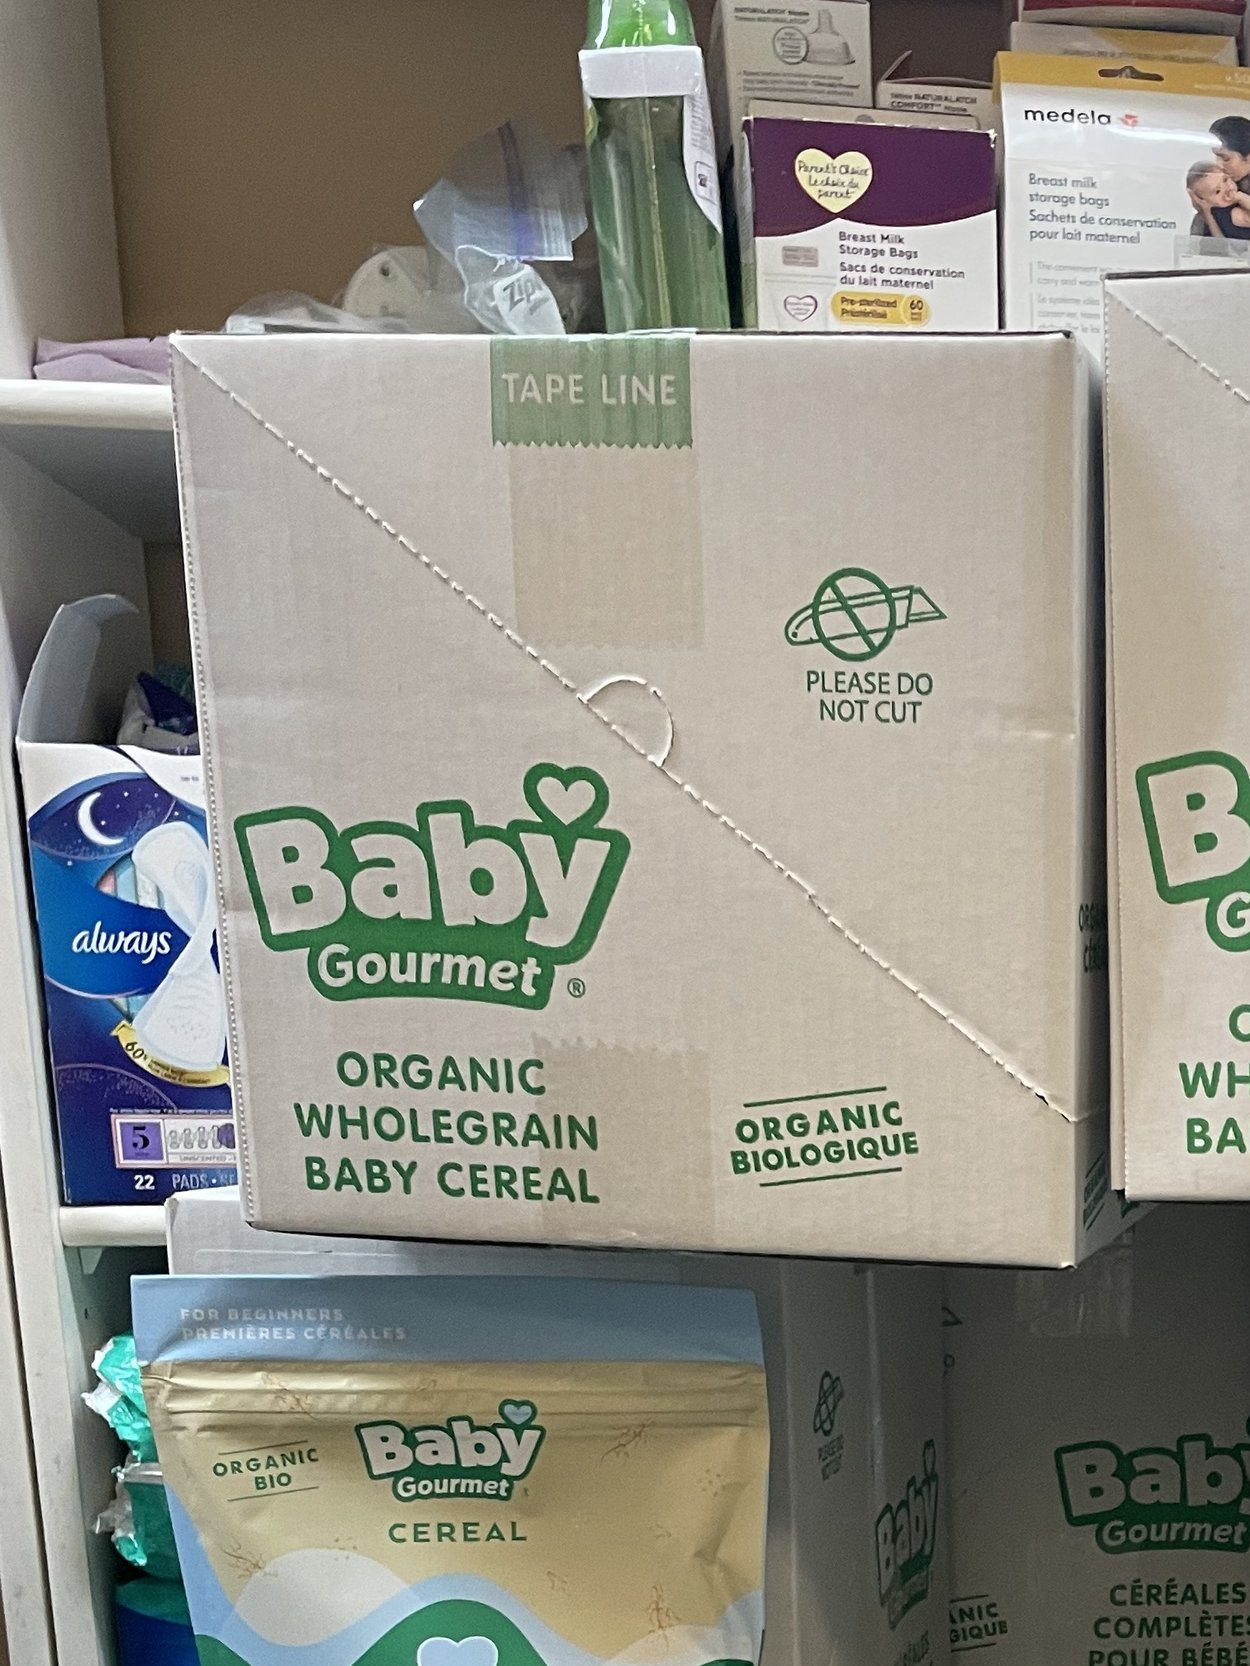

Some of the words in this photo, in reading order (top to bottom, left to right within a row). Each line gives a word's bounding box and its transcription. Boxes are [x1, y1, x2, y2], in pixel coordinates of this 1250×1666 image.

[1024, 108, 1112, 126] medela
[799, 160, 837, 175] Parent's
[1028, 173, 1068, 188] Breast
[1071, 176, 1098, 189] milk
[1029, 192, 1076, 208] storage
[1079, 193, 1110, 208] bags
[1029, 209, 1077, 224] Sachets
[1079, 211, 1096, 225] de
[1098, 215, 1177, 230] conservation
[838, 231, 876, 244] Breast
[880, 233, 905, 245] Milk
[1029, 230, 1059, 243] pour
[1062, 229, 1082, 241] lait
[1085, 231, 1141, 245] maternel
[838, 244, 886, 259] Storage
[889, 246, 919, 260] Bags
[839, 262, 868, 273] Sacs
[870, 263, 886, 274] de
[889, 266, 966, 279] conservation
[840, 275, 855, 286] du
[858, 275, 878, 288] lait
[881, 276, 934, 290] maternel
[909, 299, 924, 311] 60
[502, 371, 585, 404] TAPE
[601, 373, 677, 405] LINE
[806, 670, 891, 696] PLEASE
[898, 672, 933, 696] DO
[819, 699, 868, 723] NOT
[874, 700, 922, 724] CUT
[234, 798, 632, 967] Baby
[71, 920, 173, 966] always
[316, 942, 542, 997] Gourmet
[336, 1050, 547, 1096] ORGANIC
[293, 1102, 599, 1152] WHOLEGRAIN
[734, 1100, 904, 1144] ORGANIC
[132, 1125, 151, 1150] 5
[730, 1131, 920, 1175] BIOLOGIQUE
[134, 1174, 156, 1190] 22
[172, 1172, 209, 1190] PADS
[304, 1155, 418, 1196] BABY
[437, 1161, 601, 1204] CEREAL
[179, 1307, 220, 1322] FOR
[228, 1308, 344, 1323] BEGINNERS
[181, 1323, 297, 1342] PREMIÈRES
[303, 1324, 407, 1342] CÉRÉALES
[355, 1415, 547, 1481] Baby
[212, 1447, 321, 1478] ORGANIC
[253, 1471, 293, 1491] BIO
[397, 1475, 510, 1499] Gourmet
[388, 1520, 528, 1545] CEREAL
[1101, 1519, 1249, 1547] Gourmet
[1109, 1577, 1247, 1607] CÉRÉALES
